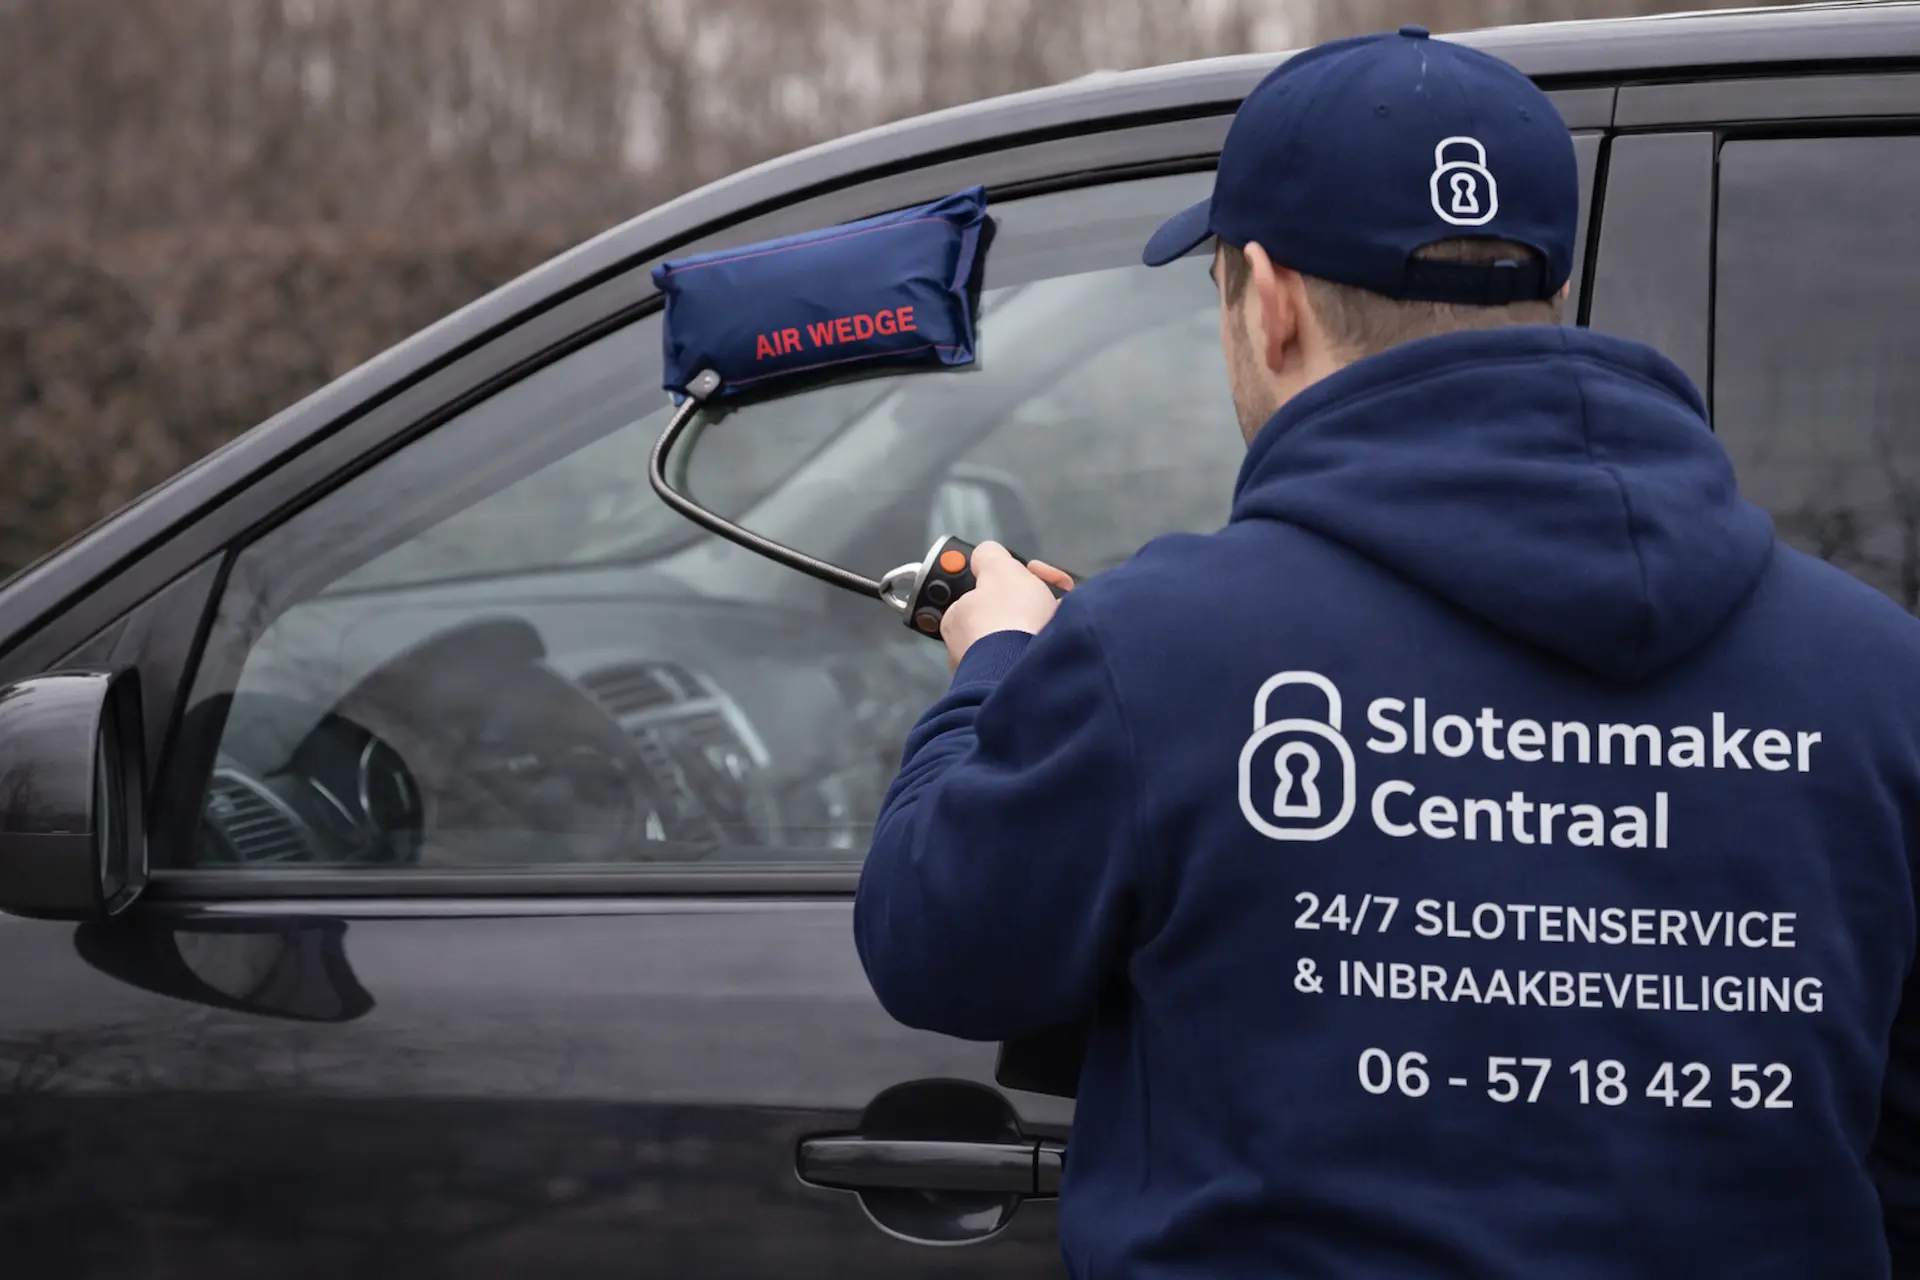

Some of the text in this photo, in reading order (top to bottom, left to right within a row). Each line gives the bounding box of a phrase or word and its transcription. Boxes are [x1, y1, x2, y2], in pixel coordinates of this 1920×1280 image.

[755, 305, 918, 361] AIR WEDGE
[1365, 696, 1822, 773] Slotenmaker
[1370, 779, 1670, 850] Centraal
[1293, 891, 1798, 949] 24/7 SLOTENSERVICE
[1292, 957, 1824, 1014] & INBRAAKBEVEILIGING
[1357, 1047, 1795, 1110] 06 - 57 18 42 52
